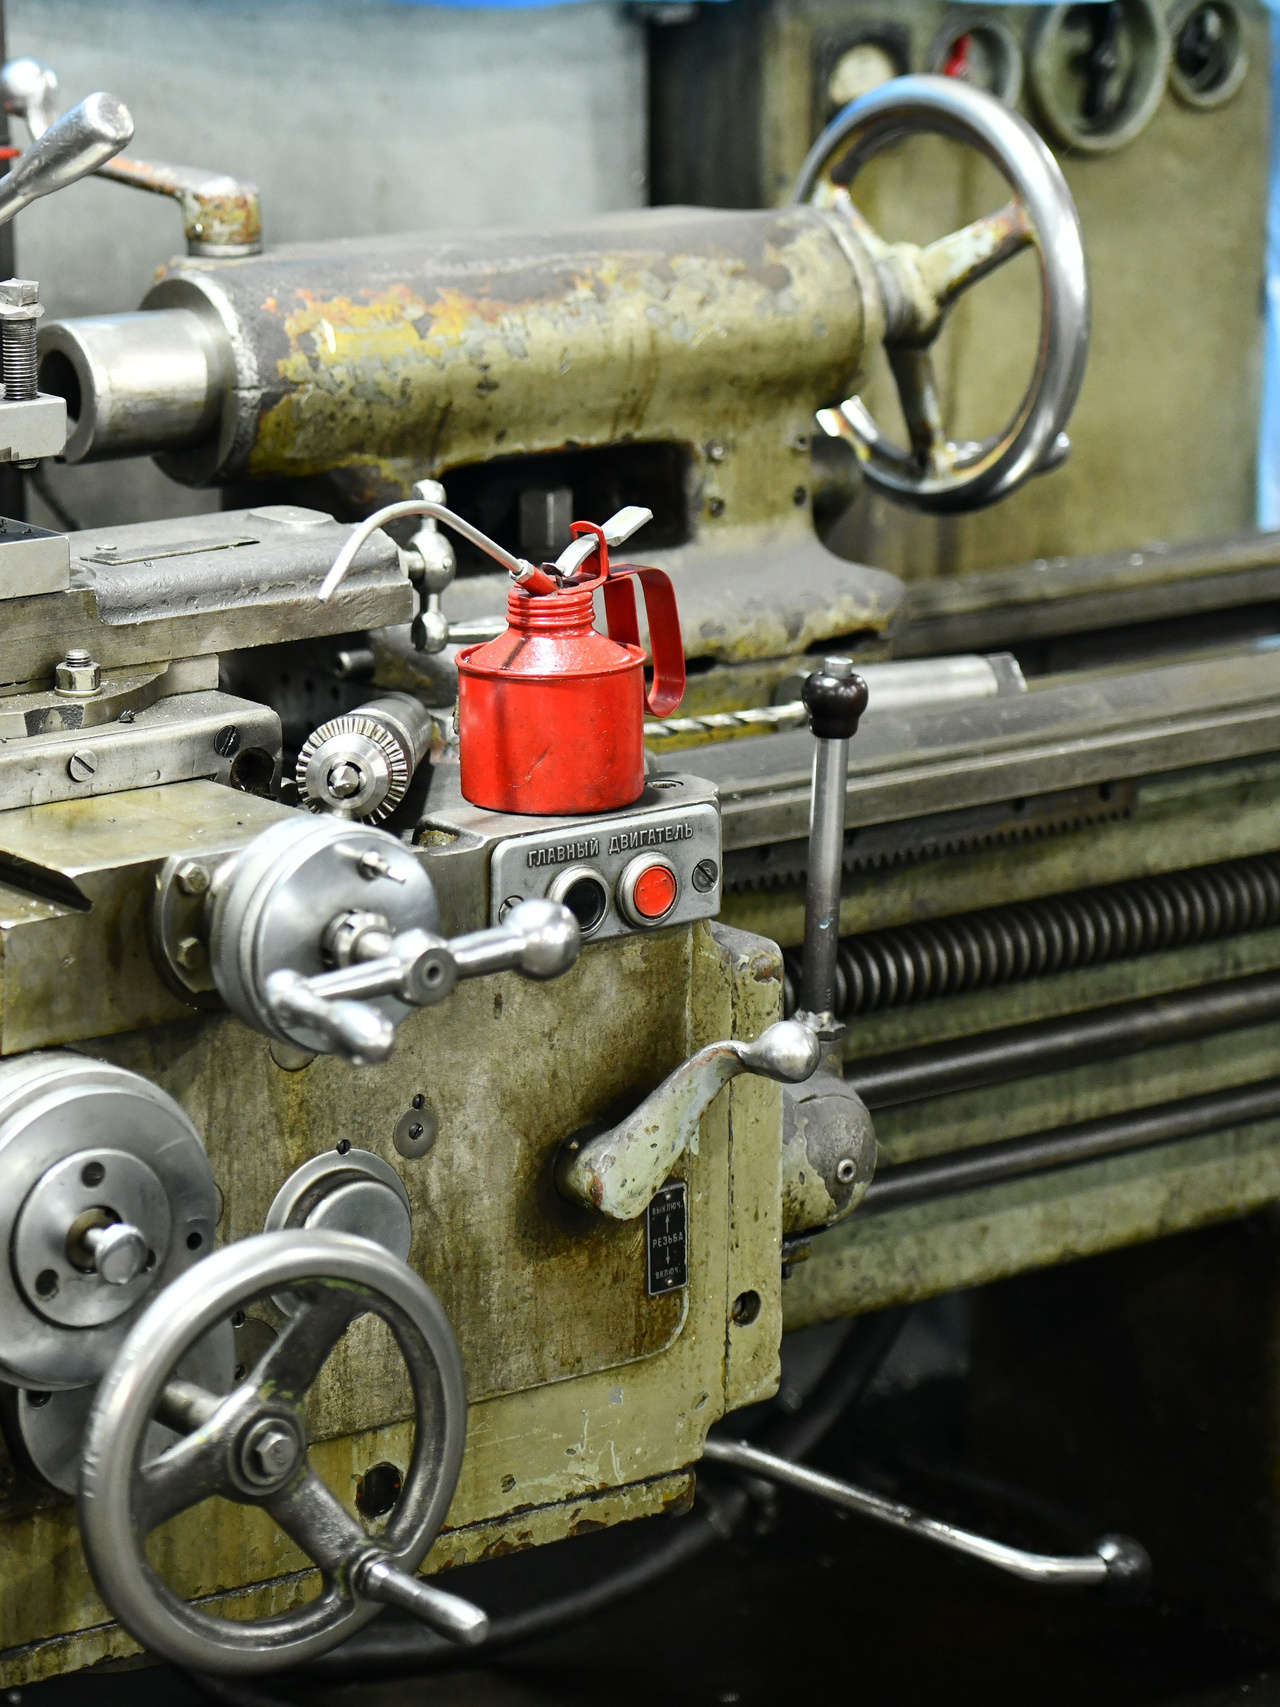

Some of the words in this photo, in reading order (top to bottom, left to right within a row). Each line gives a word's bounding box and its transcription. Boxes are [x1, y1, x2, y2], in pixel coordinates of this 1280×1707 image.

[527, 837, 600, 868] ГЛАВНЫЙ
[608, 822, 694, 855] ДВИГАТЕЛЬ
[652, 1231, 684, 1249] РЕЗЬБА
